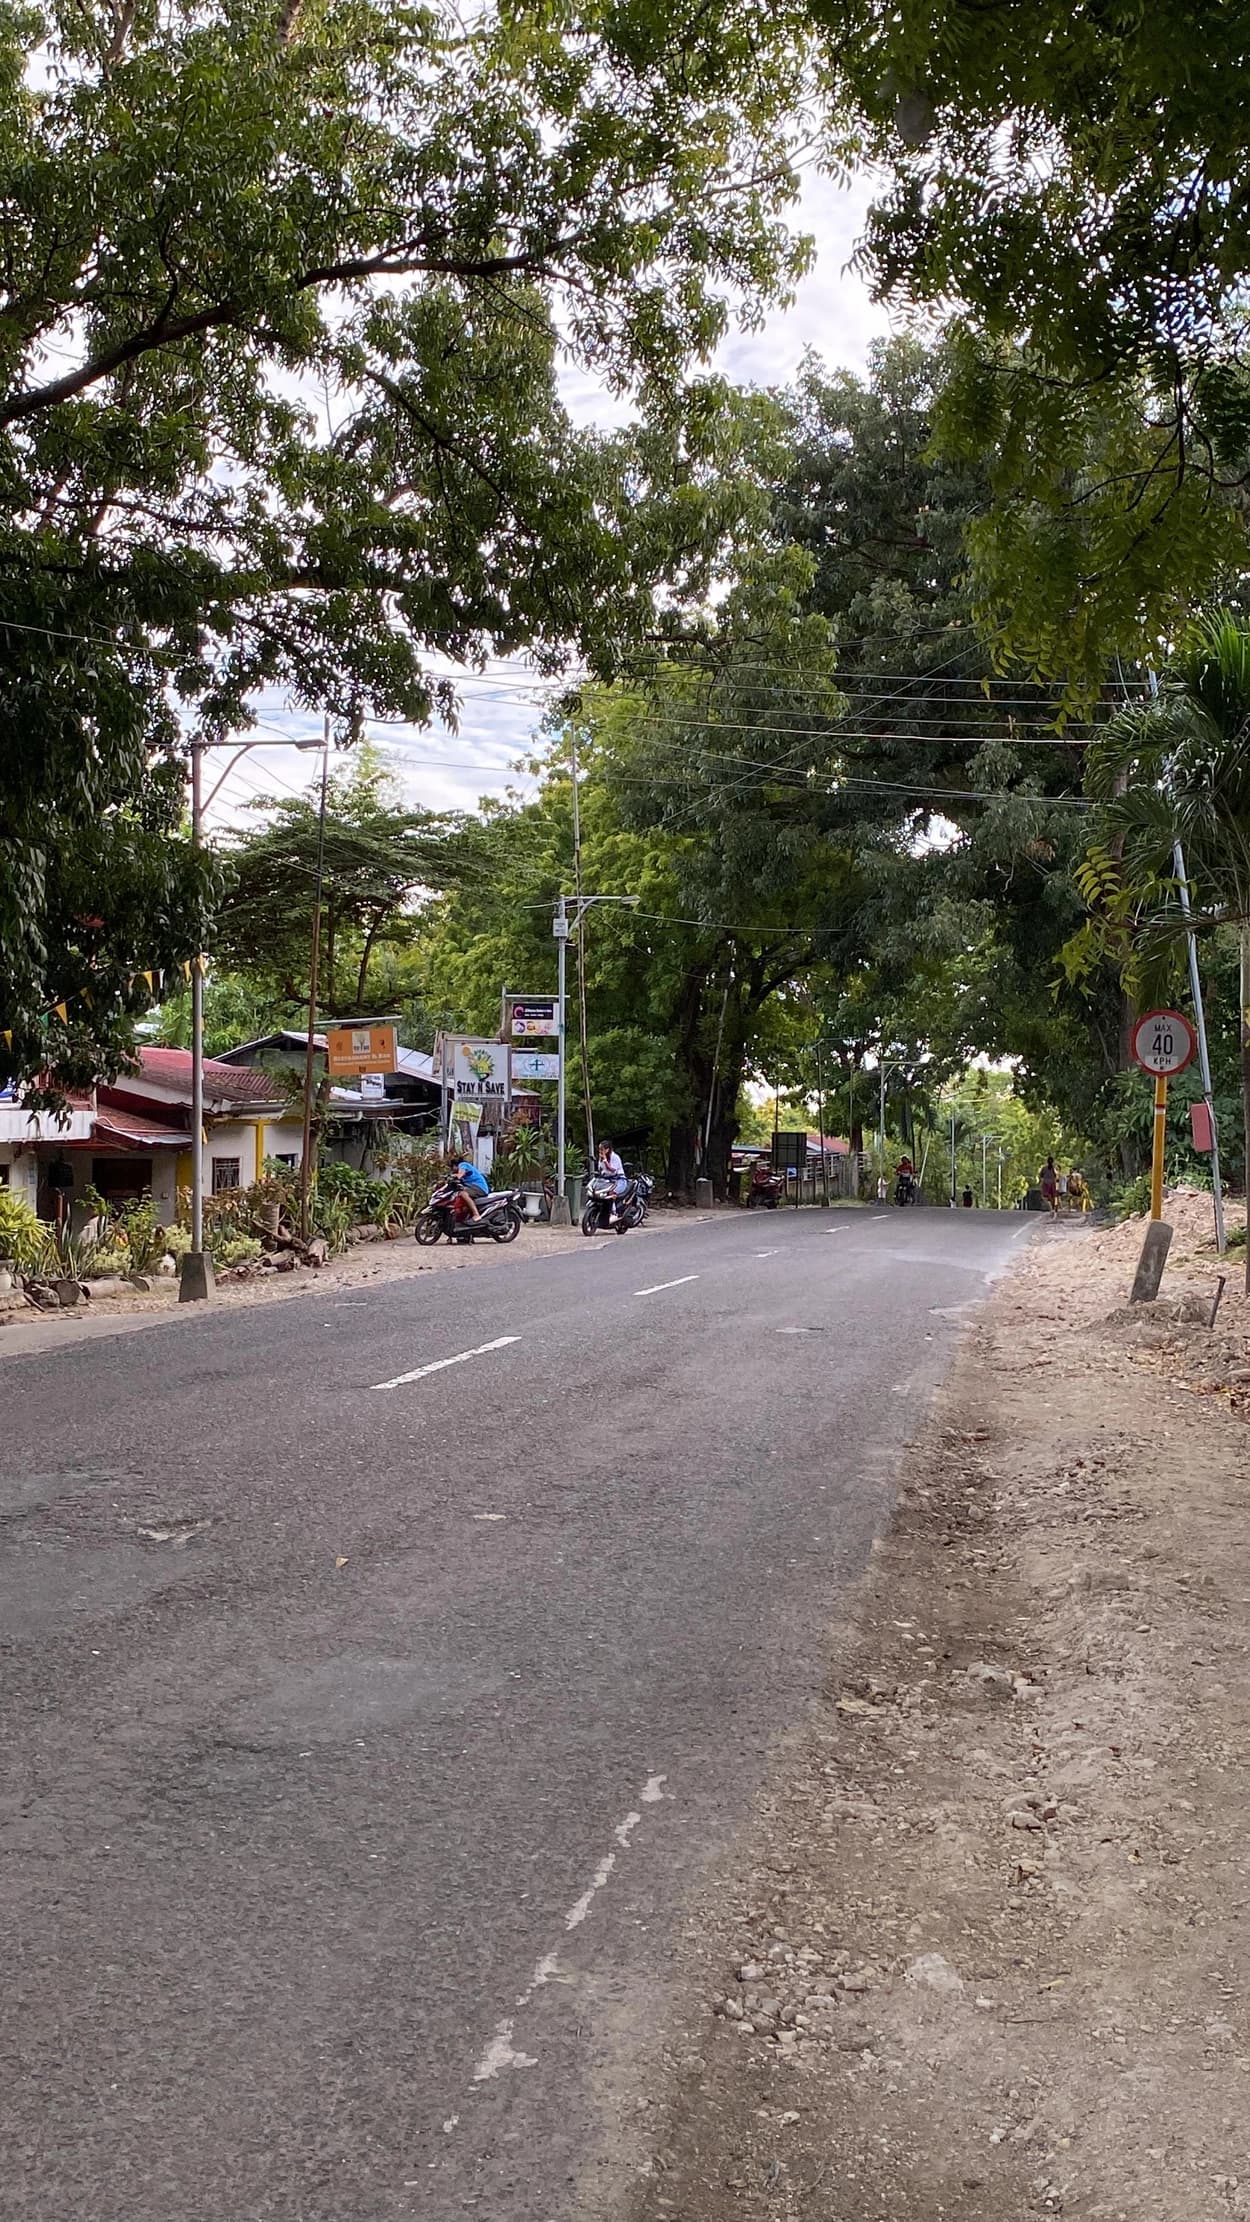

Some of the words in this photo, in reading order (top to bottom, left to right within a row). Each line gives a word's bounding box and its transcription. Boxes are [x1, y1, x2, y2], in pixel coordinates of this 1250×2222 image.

[1154, 1024, 1172, 1032] MAX
[1152, 1034, 1173, 1055] 40
[457, 1080, 475, 1094] STAY
[477, 1082, 483, 1094] N
[485, 1080, 505, 1095] SAVE
